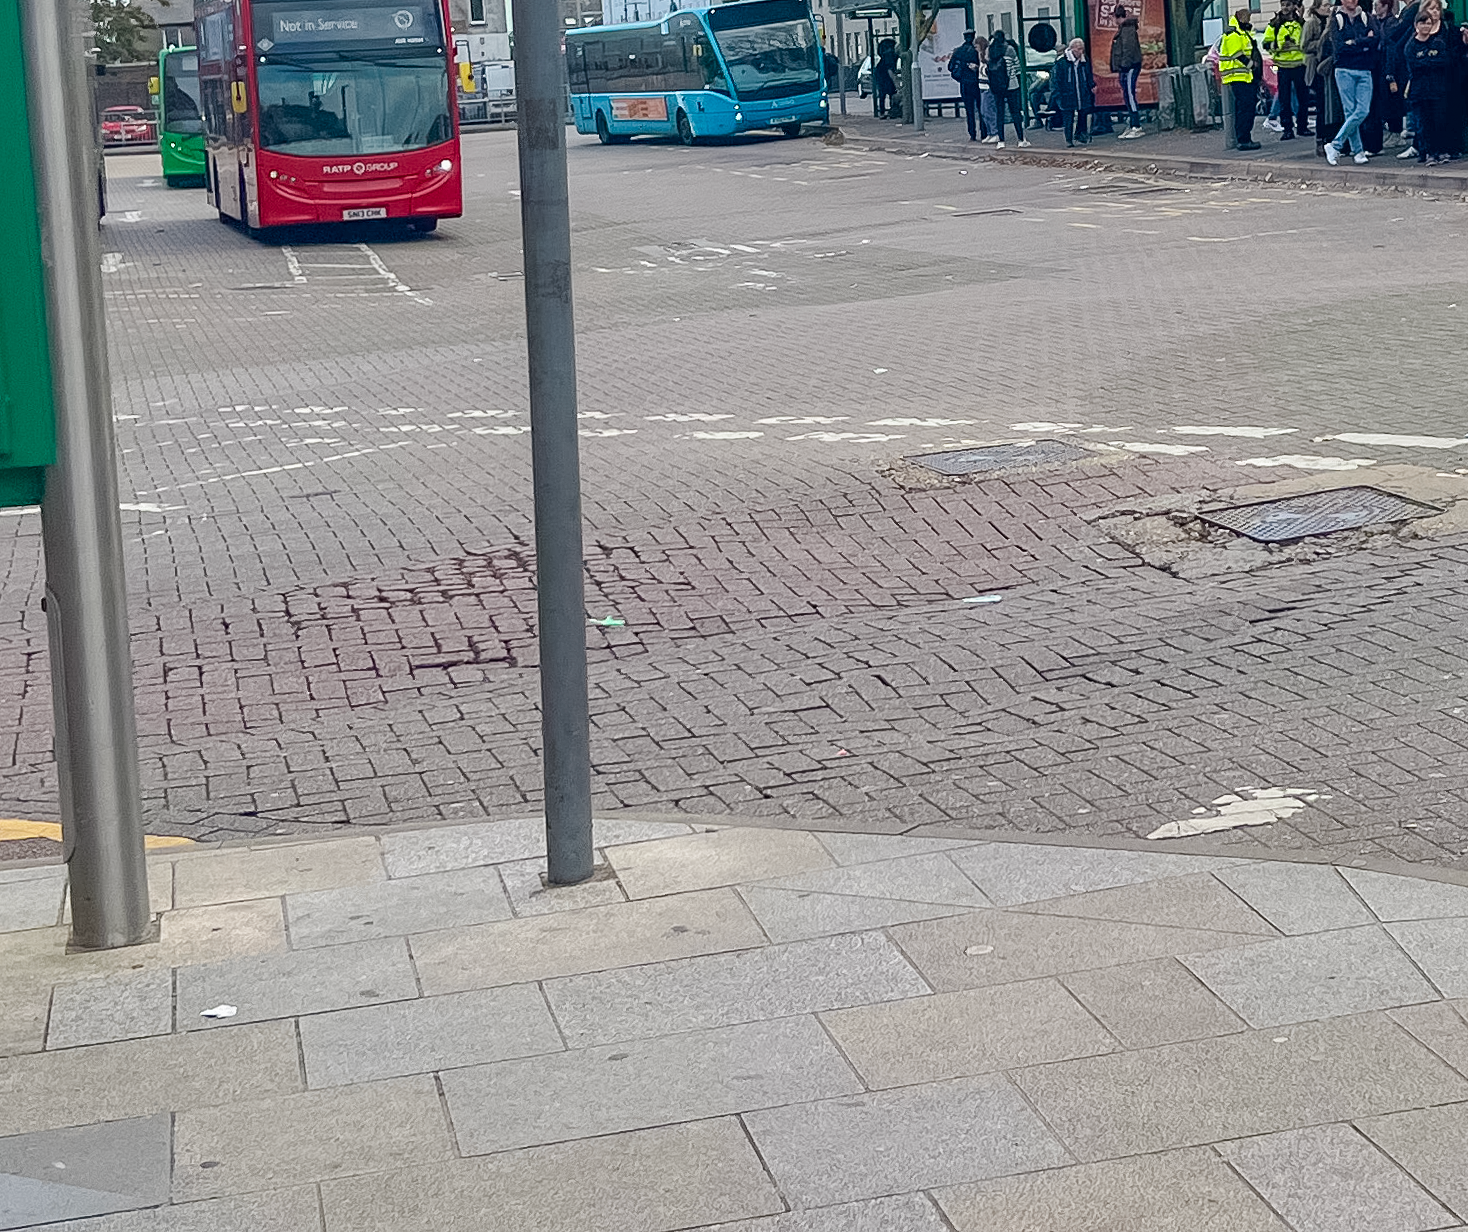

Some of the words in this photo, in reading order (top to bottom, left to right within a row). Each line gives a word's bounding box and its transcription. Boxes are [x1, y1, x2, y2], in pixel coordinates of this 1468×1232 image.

[280, 19, 302, 33] Not
[304, 20, 315, 31] in
[317, 18, 359, 31] Service
[322, 165, 352, 174] RATP
[365, 162, 399, 172] GROUP
